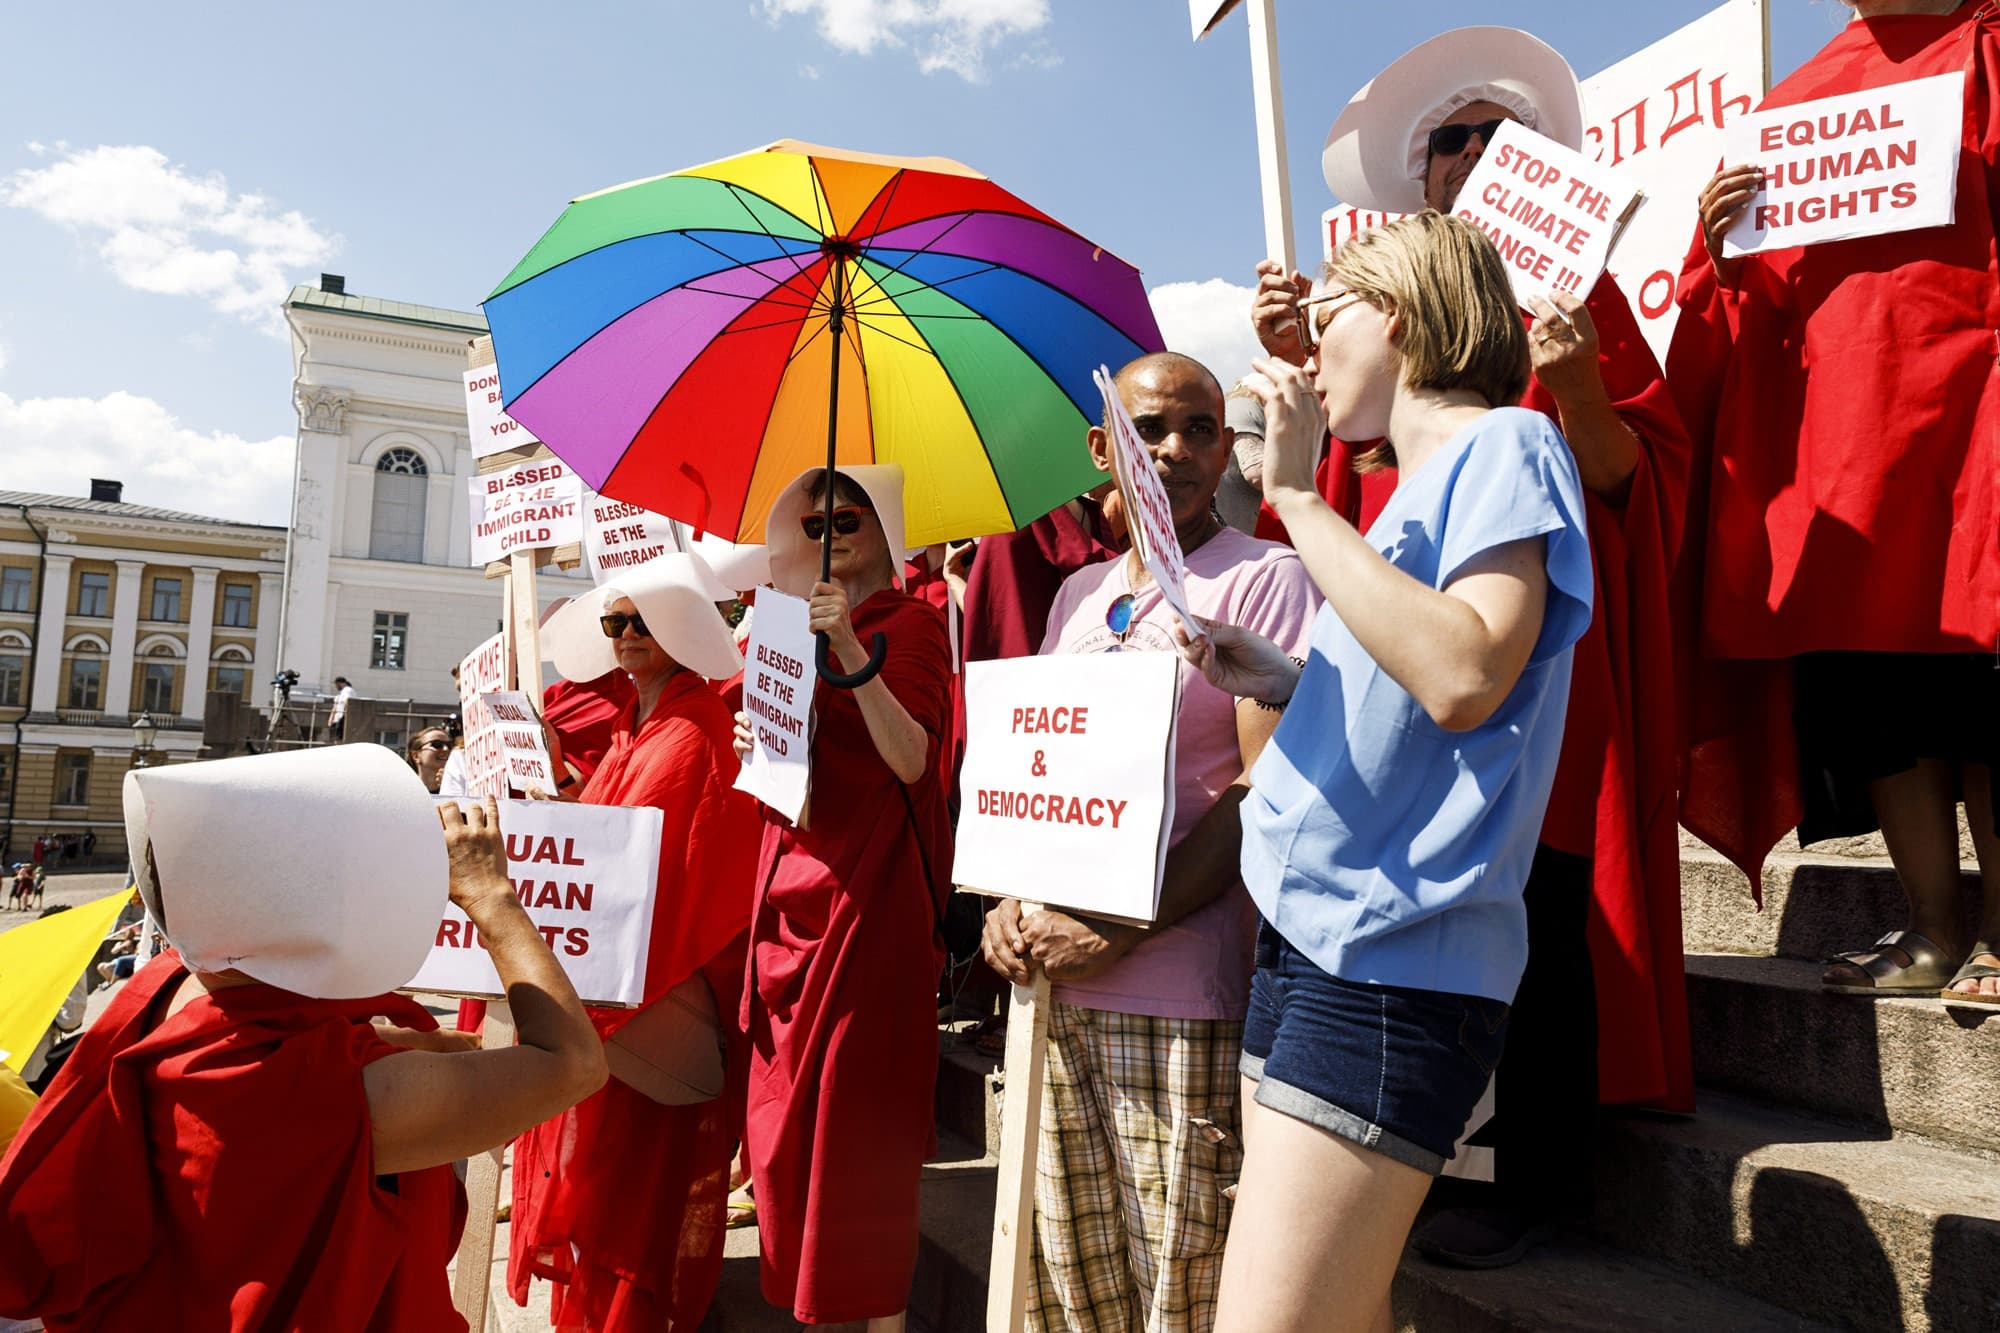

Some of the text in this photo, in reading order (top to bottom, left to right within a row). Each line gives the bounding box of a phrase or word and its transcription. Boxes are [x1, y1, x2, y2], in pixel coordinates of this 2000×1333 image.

[1760, 104, 1903, 152] EQUAL
[1757, 140, 1917, 191] HUMAN
[1495, 144, 1612, 223] STOP THE
[1482, 182, 1591, 255] CLIMATE
[1755, 182, 1917, 230] RIGHTS
[1552, 267, 1583, 295] !!!
[487, 465, 562, 494] BLESSED
[477, 502, 576, 537] IMMIGRANT
[594, 502, 645, 523] BLESSED
[501, 528, 551, 550] CHILD
[603, 524, 646, 545] BE THE
[598, 545, 664, 570] IMMIGRANT
[478, 642, 500, 687] MAKE
[757, 644, 803, 680] BLESSED
[757, 672, 794, 706] BE THE
[494, 704, 528, 721] EQUAL
[747, 693, 803, 738] IMMIGRANT
[1012, 707, 1088, 734] PEACE
[503, 731, 537, 750] HUMAN
[758, 726, 788, 756] CHILD
[510, 758, 544, 779] RIGHTS
[1031, 750, 1046, 776] &
[978, 790, 1128, 828] DEMOCRACY
[435, 919, 589, 957] RITS
